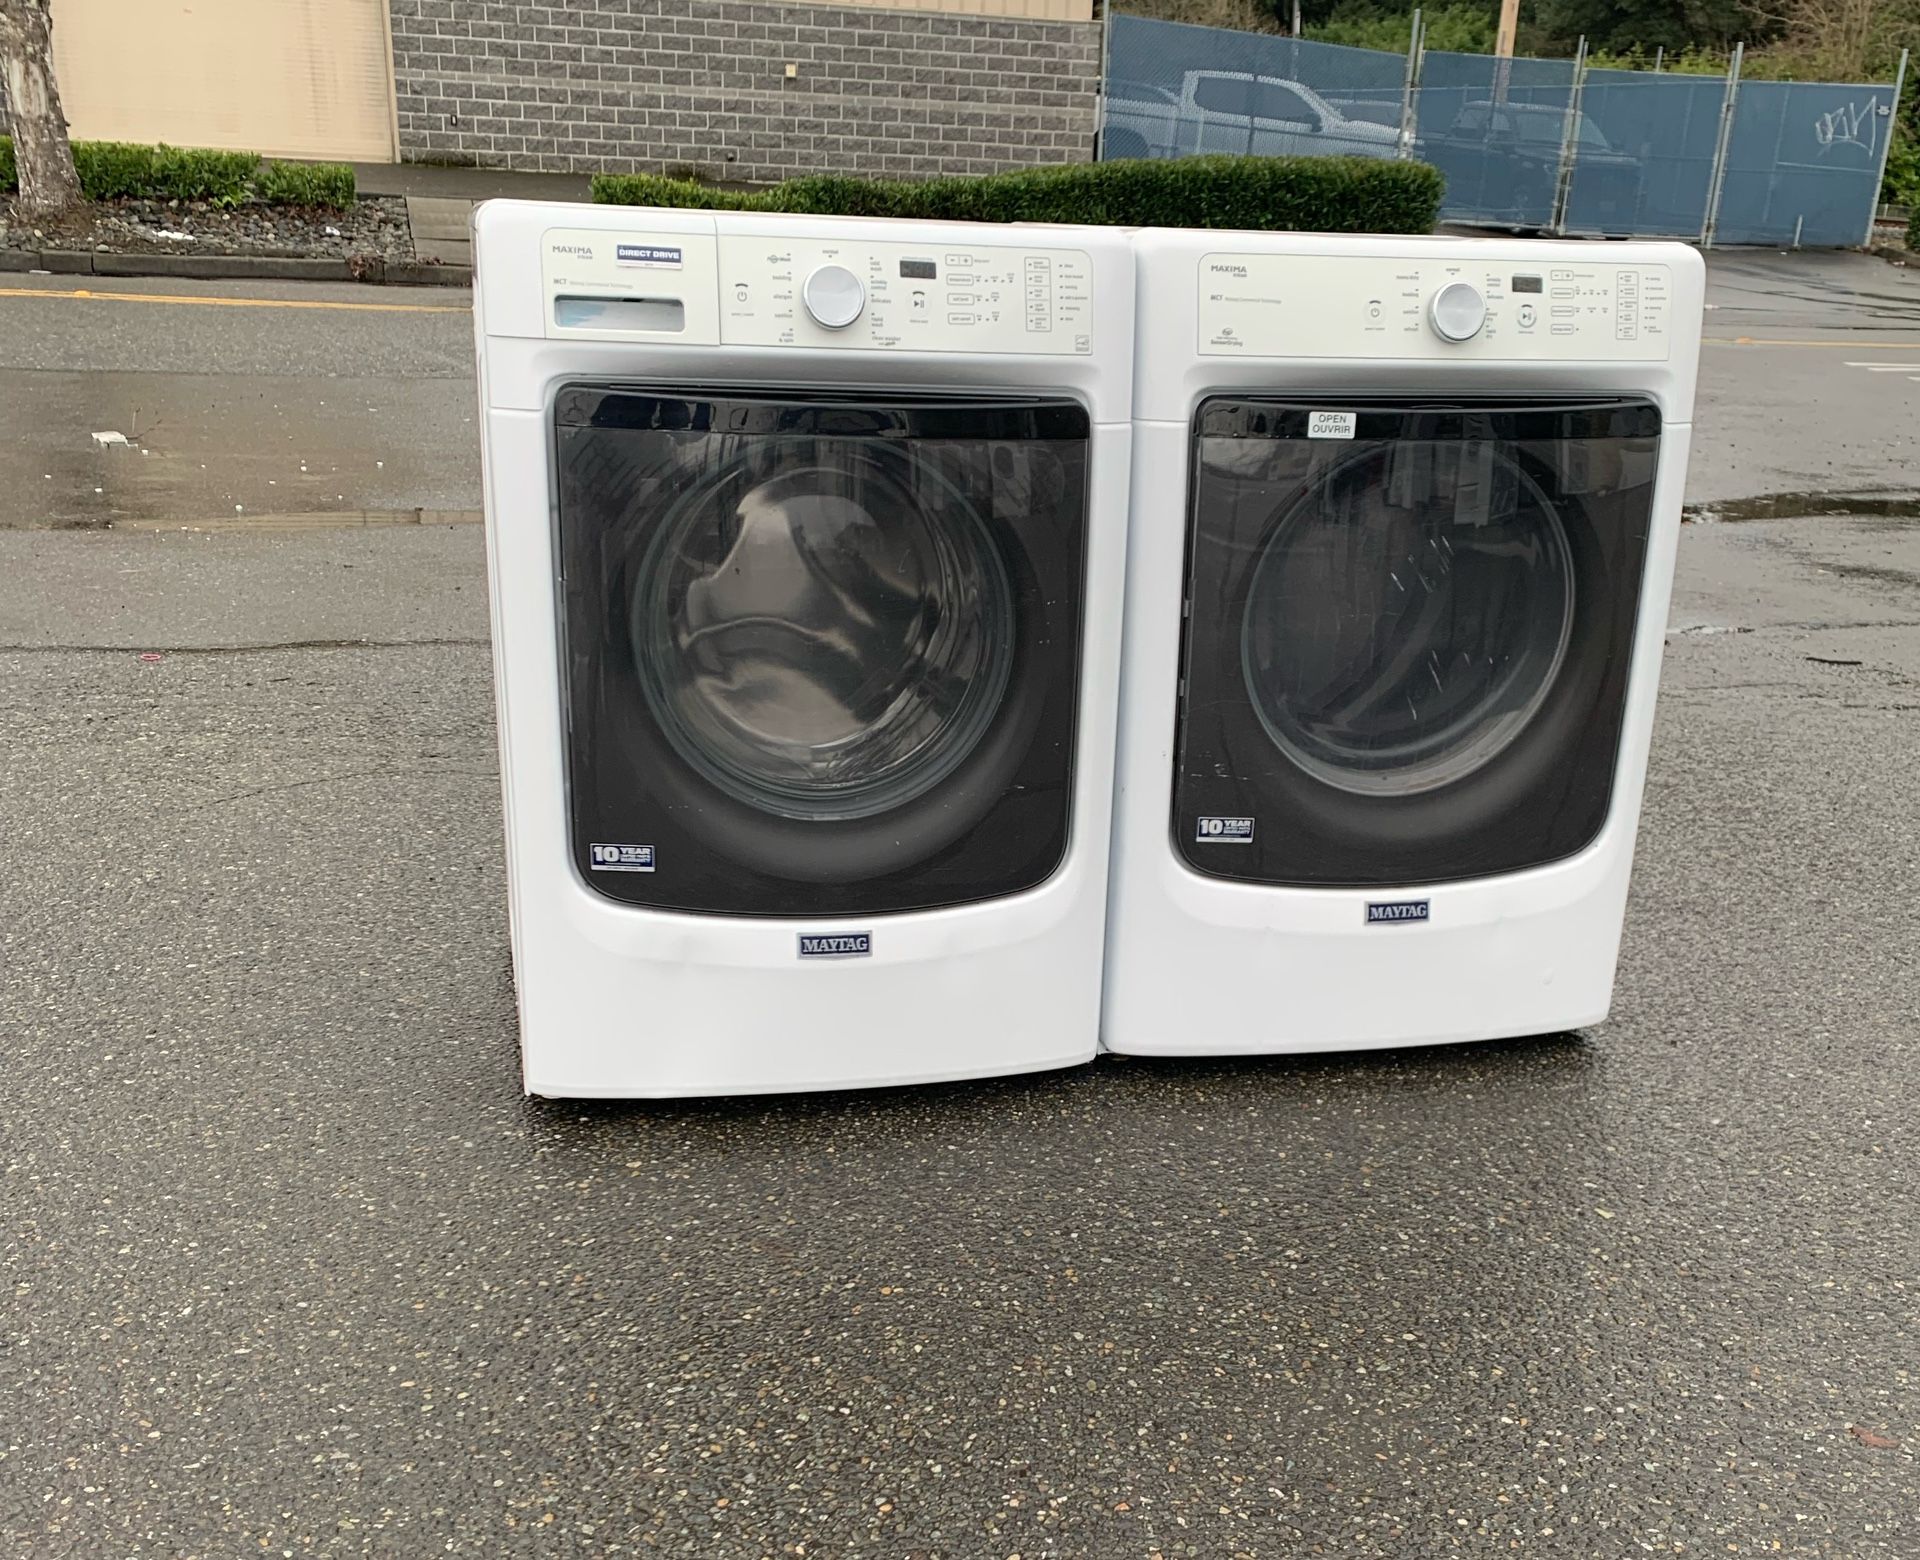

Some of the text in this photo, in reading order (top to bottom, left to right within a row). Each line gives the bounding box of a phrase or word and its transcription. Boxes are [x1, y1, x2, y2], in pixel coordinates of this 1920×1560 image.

[552, 245, 593, 255] MAXIMA
[618, 248, 680, 260] DIRECT DRIVE
[1210, 264, 1247, 273] MAXIMA
[1318, 414, 1347, 424] OPEN
[1312, 424, 1351, 434] OUVRIR
[1200, 819, 1223, 834] 10
[593, 846, 620, 862] 10
[620, 847, 651, 855] YEAR
[1370, 904, 1427, 920] MAYTAG
[802, 937, 868, 953] MAYTAG
